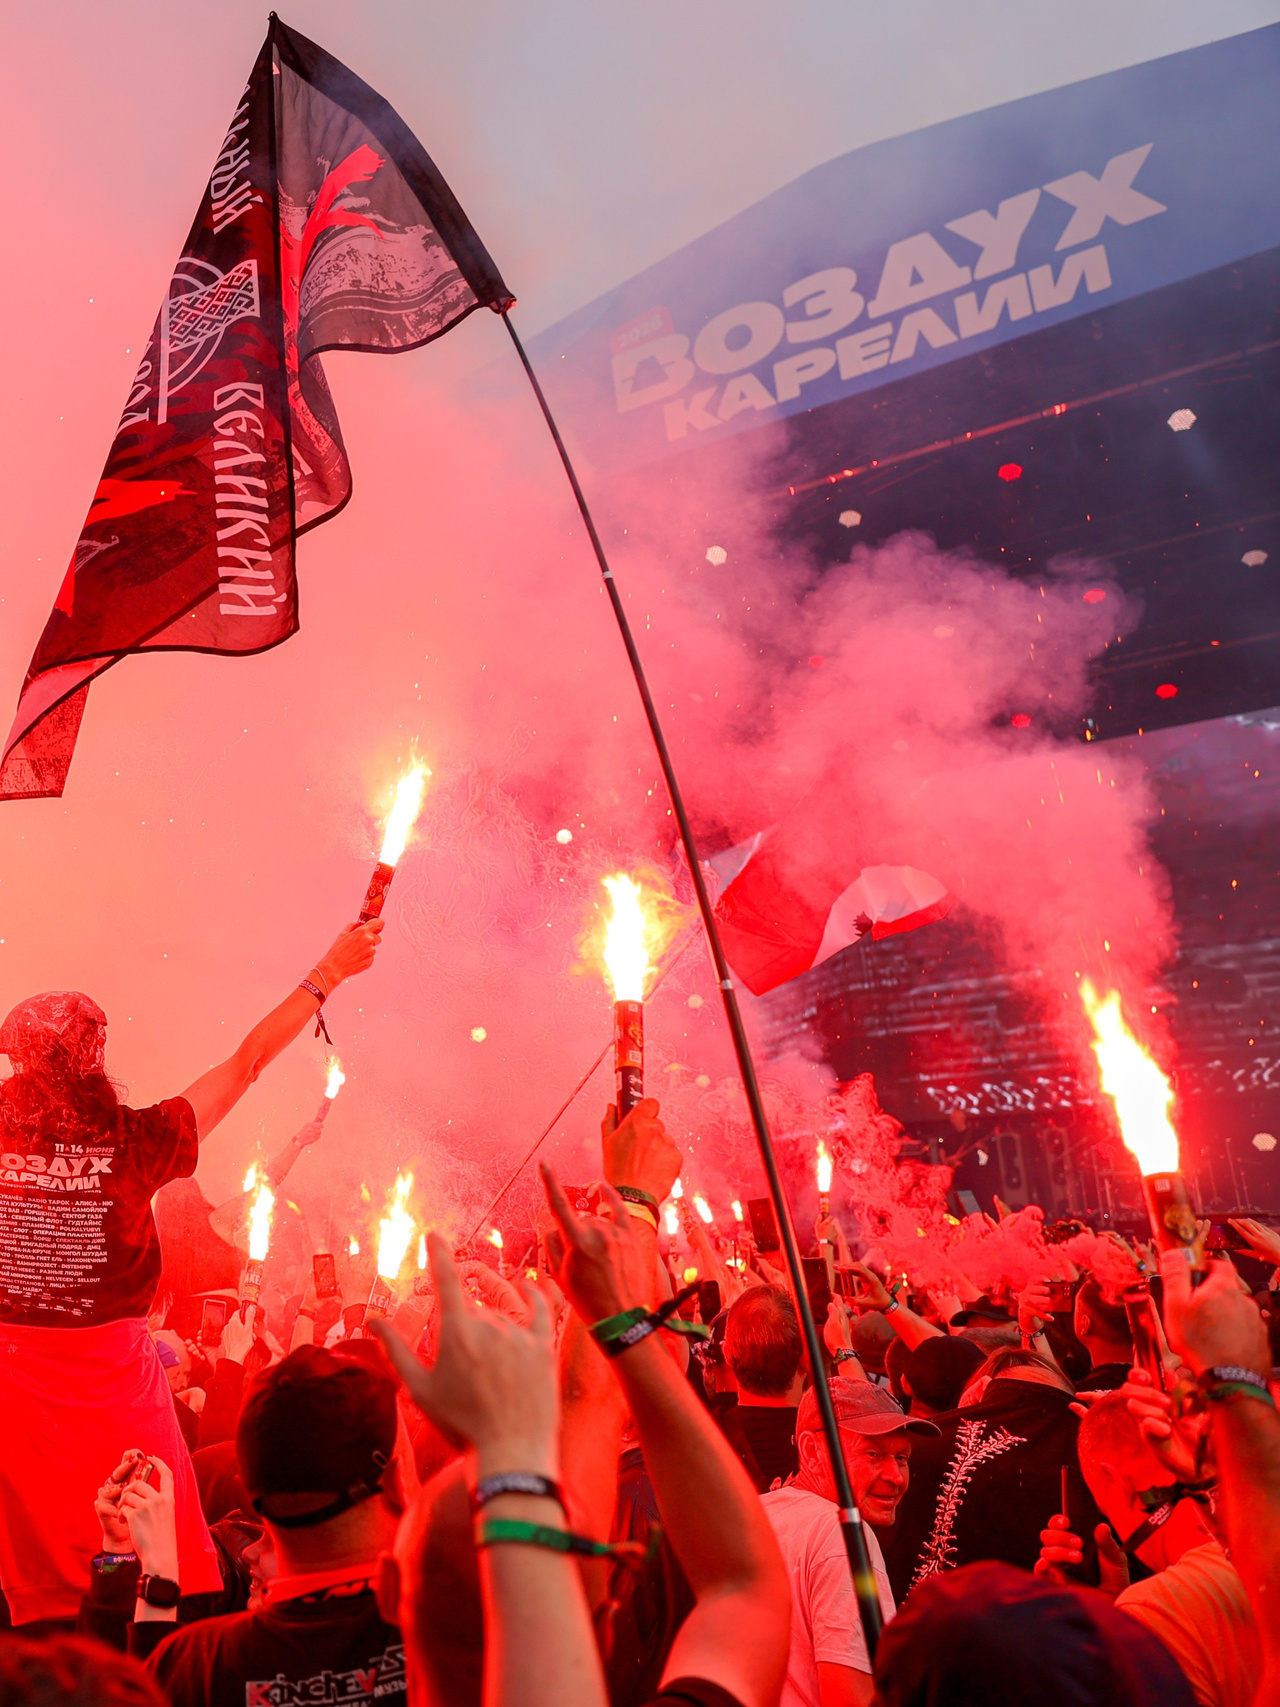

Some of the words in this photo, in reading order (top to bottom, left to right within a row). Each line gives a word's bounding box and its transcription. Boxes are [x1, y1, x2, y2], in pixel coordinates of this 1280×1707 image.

[611, 143, 1168, 413] ВОЗДУХ
[663, 244, 1113, 442] КАРЕЛИИ
[213, 381, 287, 615] ВЕЛИКИЙ
[55, 1143, 64, 1153] 11
[71, 1144, 83, 1154] 14
[11, 1214, 45, 1222] СЕВЕРНЫЙ
[14, 1279, 45, 1287] СТЕПАНОВА
